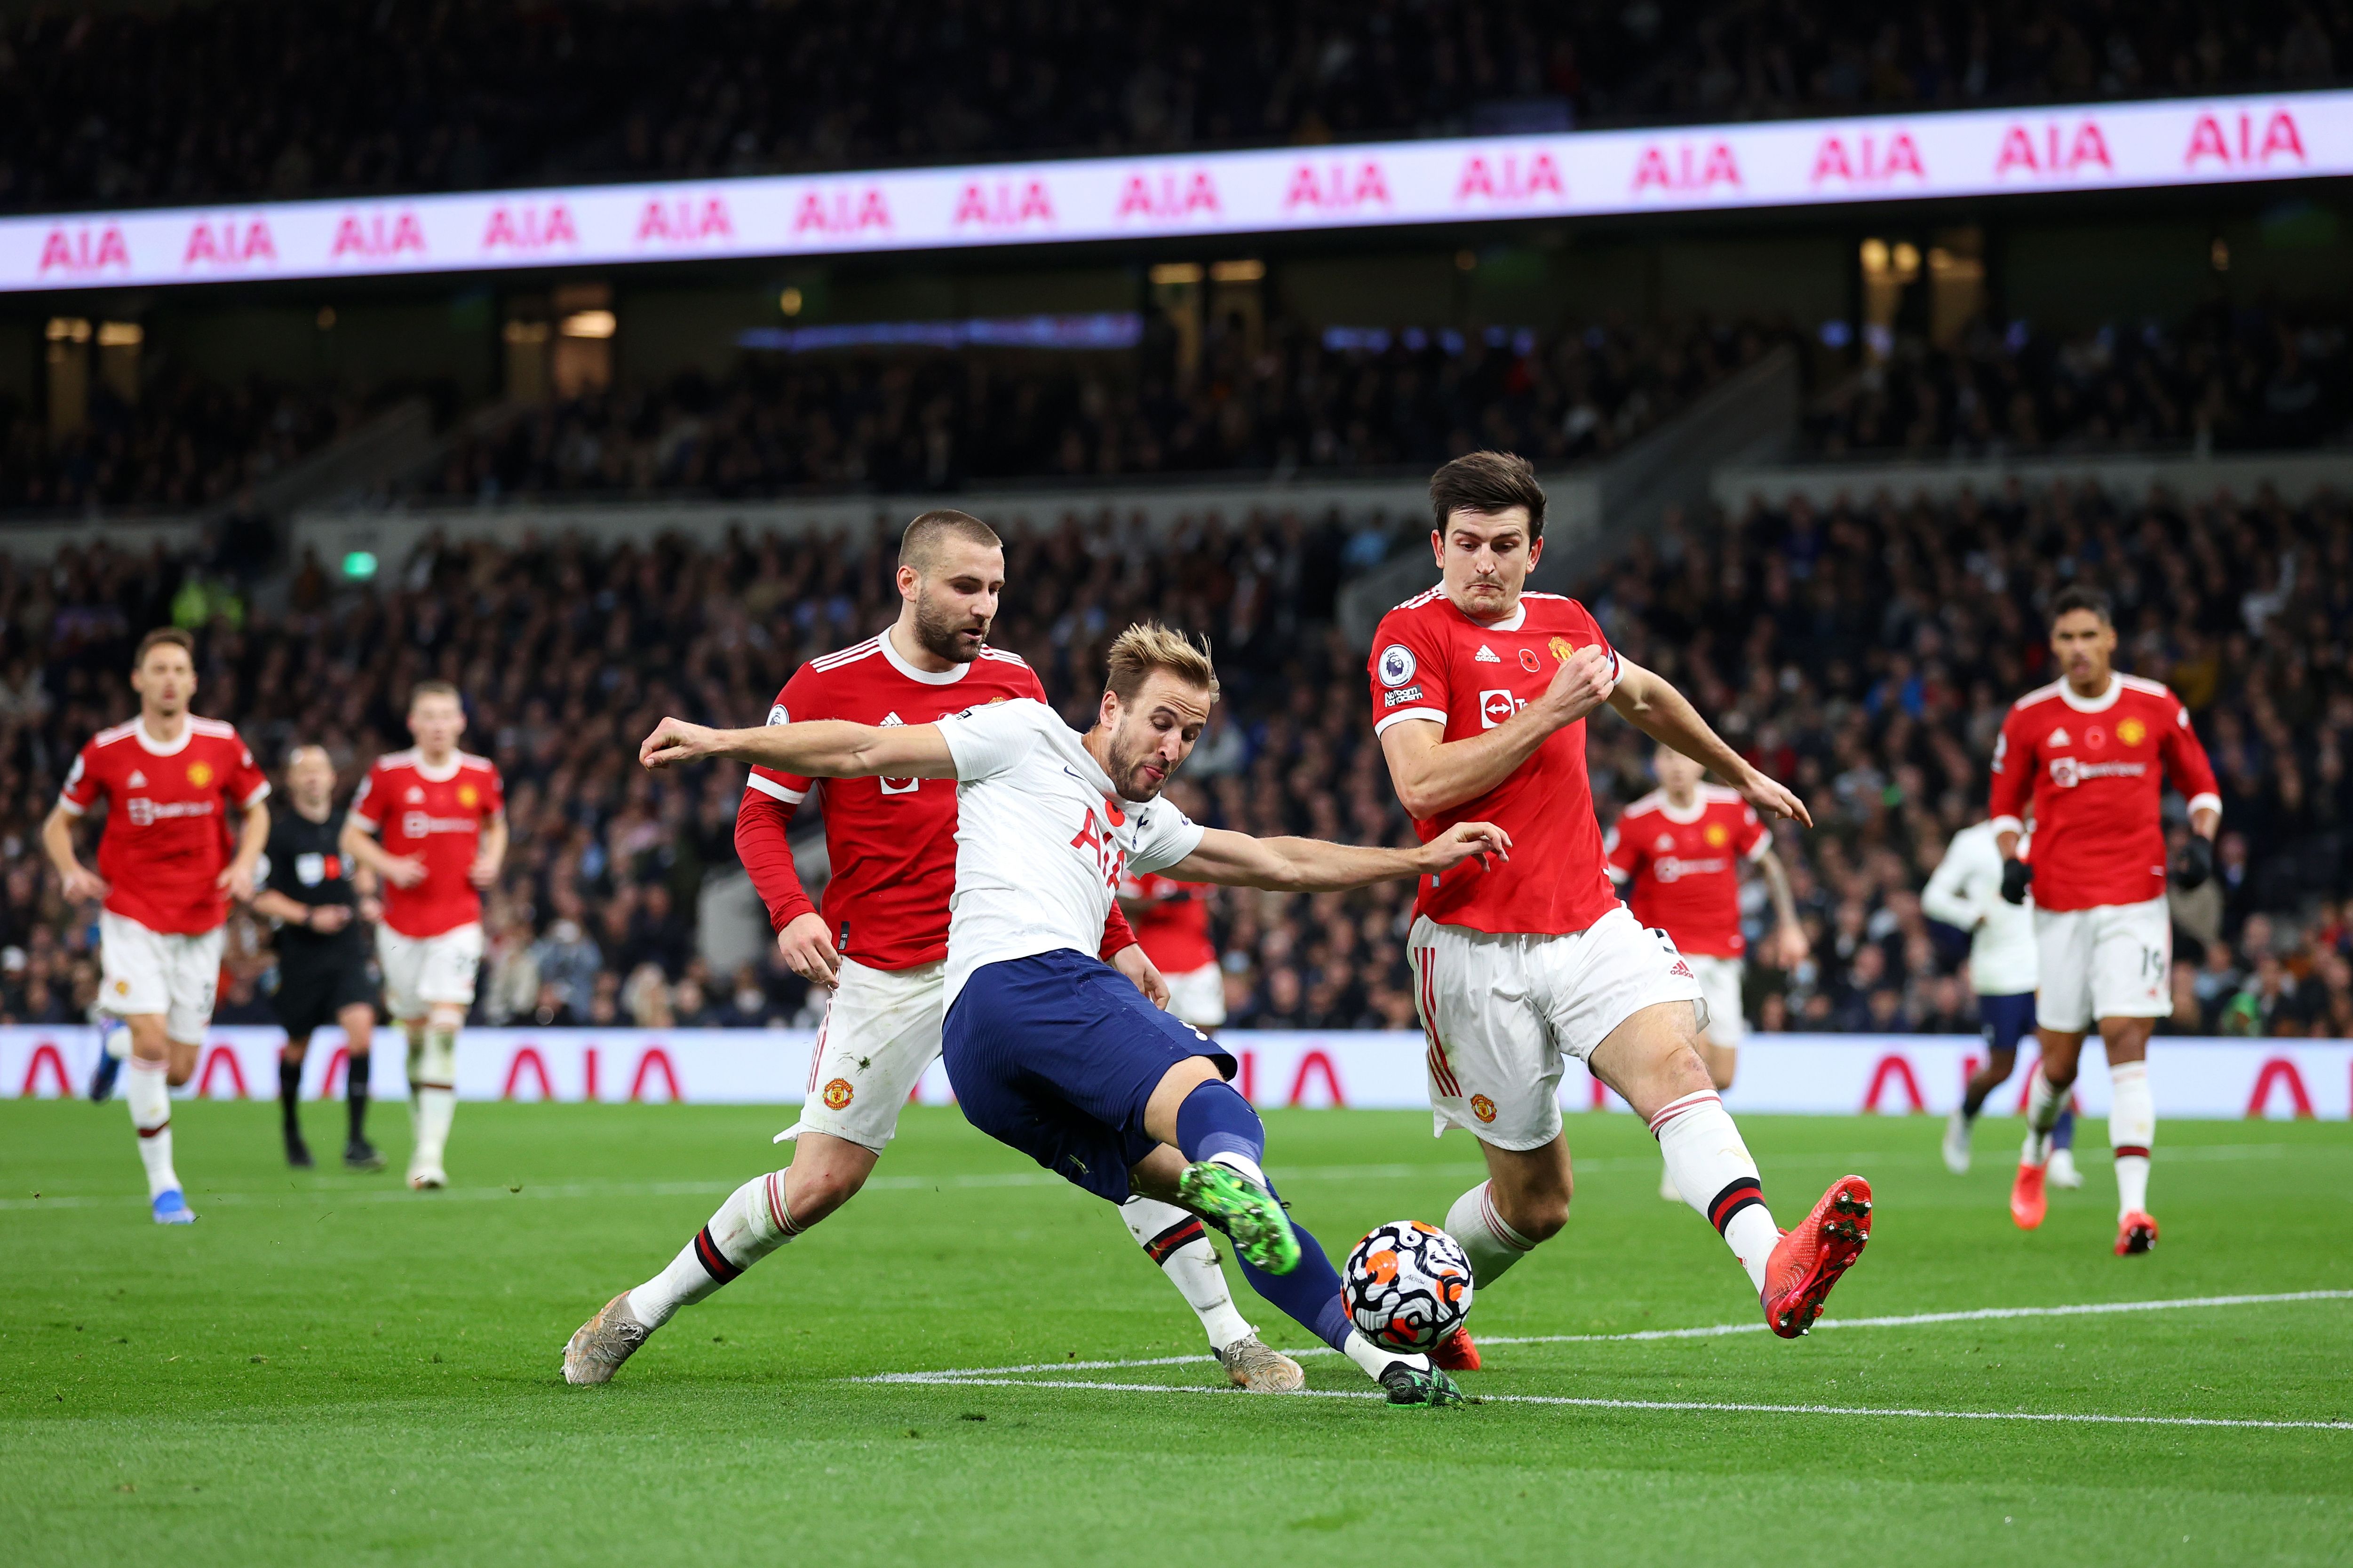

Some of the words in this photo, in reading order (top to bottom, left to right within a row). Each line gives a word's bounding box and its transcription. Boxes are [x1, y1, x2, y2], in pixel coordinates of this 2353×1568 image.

[1812, 130, 1926, 183] AIA
[1995, 119, 2114, 174] AIA
[2184, 107, 2307, 166] AIA
[1287, 160, 1390, 208] AIA
[1458, 150, 1564, 199] AIA
[1633, 142, 1741, 190] AIA
[794, 188, 890, 234] AIA
[955, 180, 1053, 226] AIA
[1119, 171, 1219, 218] AIA
[183, 220, 274, 264] AIA
[332, 212, 424, 257] AIA
[483, 205, 575, 249] AIA
[637, 197, 731, 241] AIA
[38, 226, 128, 273] AIA
[1475, 654, 1501, 663] adidas
[1393, 687, 1418, 697] room
[1395, 692, 1423, 704] racism
[1070, 808, 1125, 890] AIA
[1670, 969, 1694, 979] adidas
[503, 1046, 681, 1101] AIA
[826, 1080, 851, 1091] MANCHESTER
